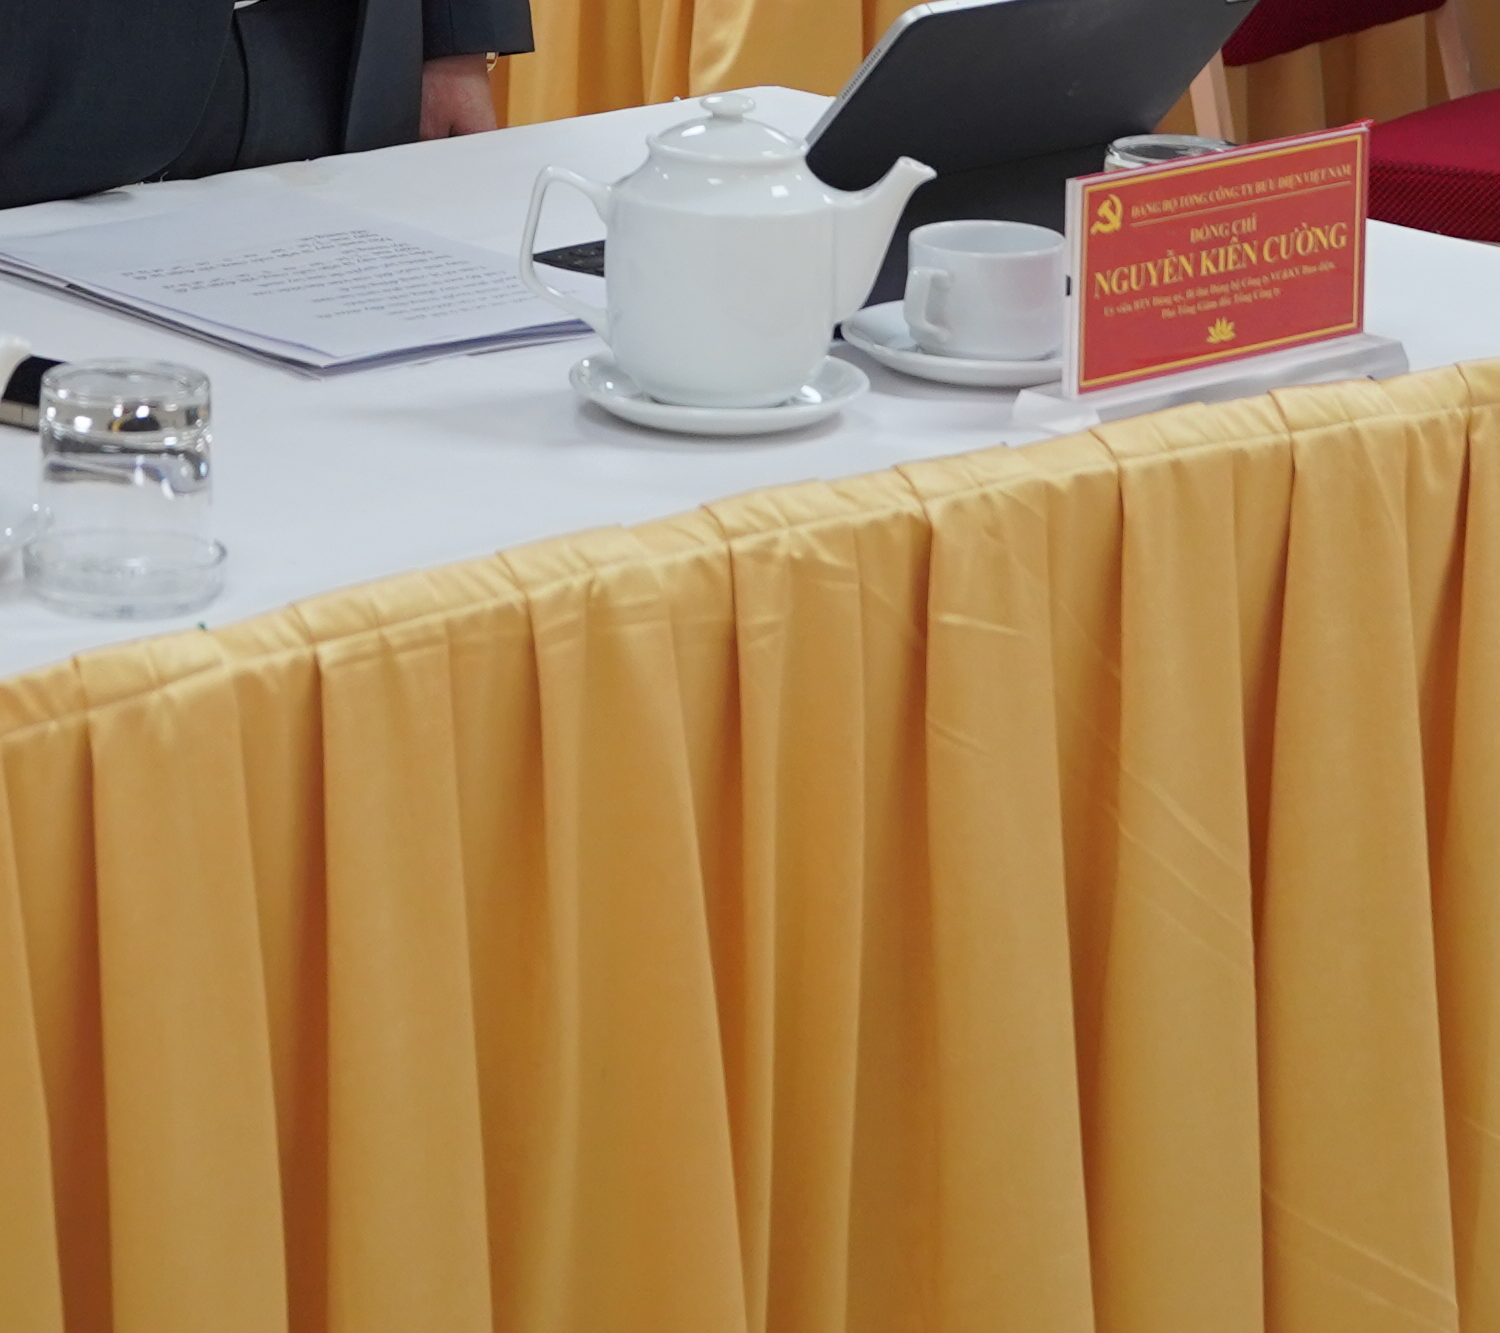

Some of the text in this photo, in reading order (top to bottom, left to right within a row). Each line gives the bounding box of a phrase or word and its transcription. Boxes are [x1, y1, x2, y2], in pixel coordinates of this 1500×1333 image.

[1232, 213, 1257, 235] CHÍ
[1094, 222, 1347, 298] NGUYỄN KIÊN CƯỜNG
